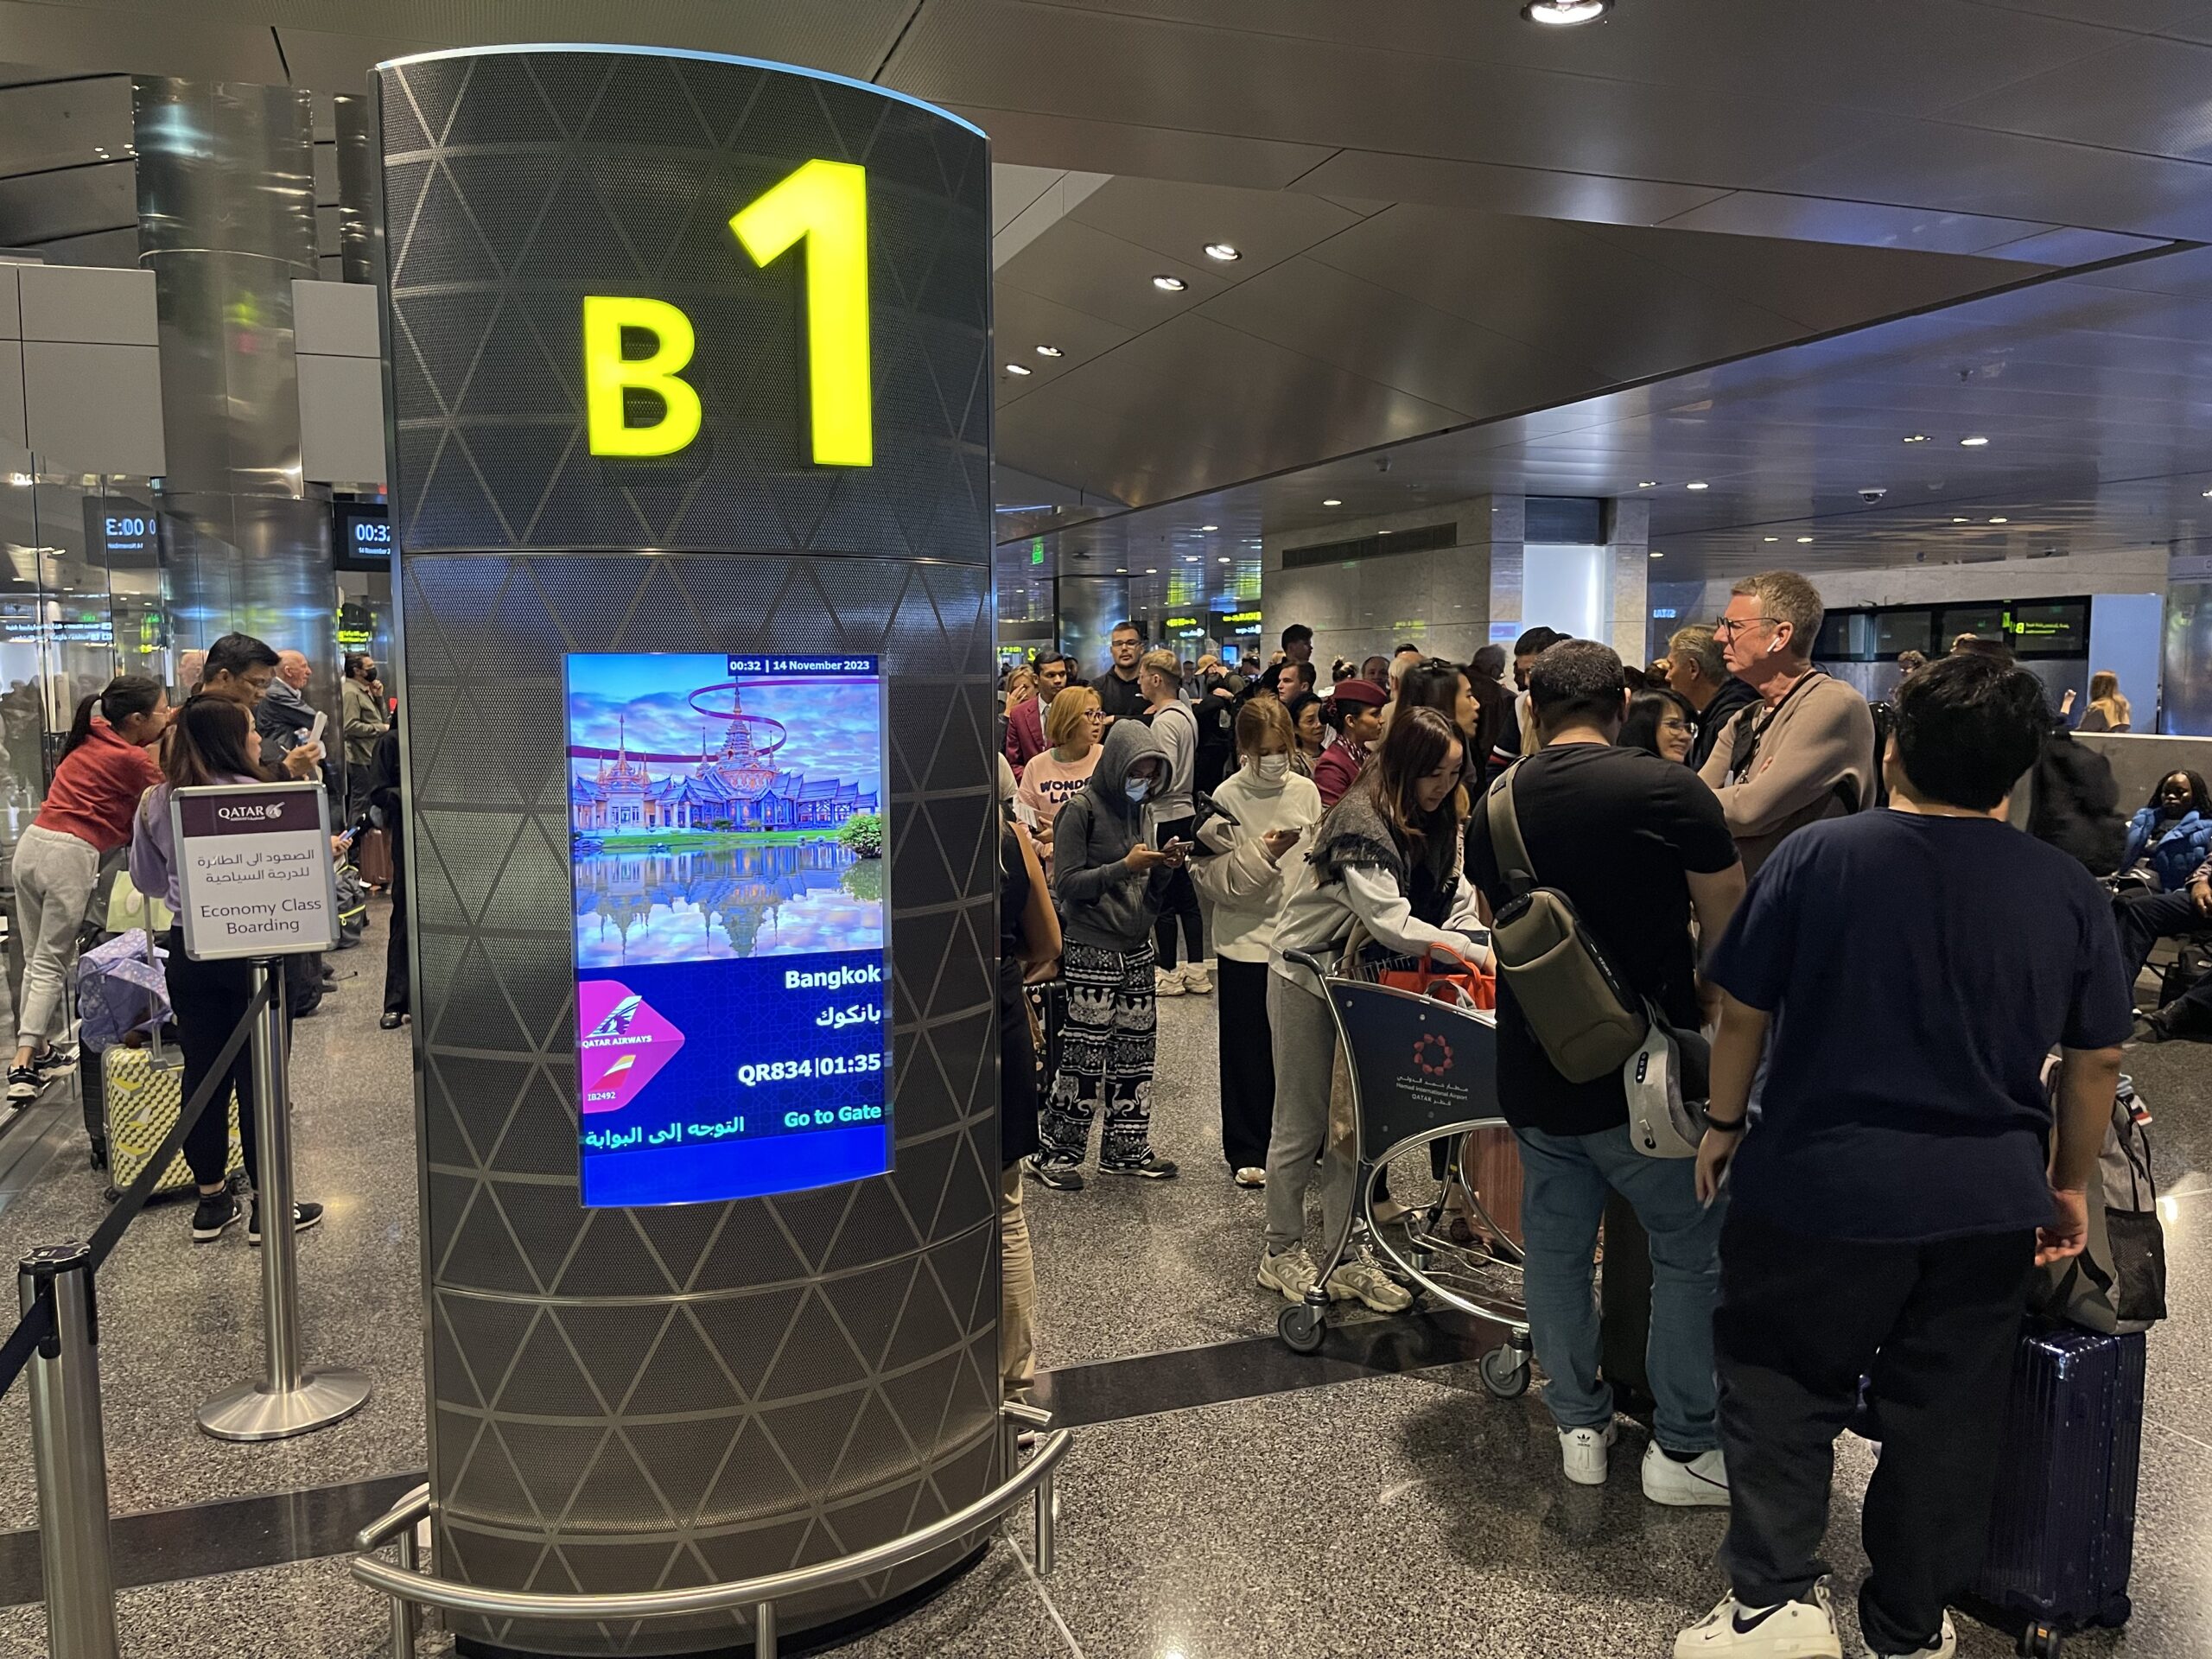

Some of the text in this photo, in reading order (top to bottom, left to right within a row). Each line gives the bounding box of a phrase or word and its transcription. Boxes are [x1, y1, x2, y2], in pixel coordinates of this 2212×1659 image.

[584, 159, 873, 467] B 1
[730, 661, 761, 671] 00:32
[773, 661, 787, 671] 14
[789, 661, 842, 671] November
[844, 661, 870, 671] 2023
[218, 805, 264, 820] QATAR
[266, 849, 315, 864] الصعود
[206, 867, 309, 885] للدرجة السياحية
[200, 899, 321, 918] Economy Class
[226, 918, 300, 935] Boarding
[785, 964, 881, 989] Bangkok
[816, 1003, 881, 1029] بانكوك
[582, 1035, 652, 1048] QATAR AIRWAYS
[588, 1091, 616, 1102] IB2492
[1411, 1093, 1432, 1102] QATAR
[1415, 1086, 1449, 1096] International
[1449, 1091, 1468, 1101] Airport
[785, 1104, 881, 1127] Go to Gate
[585, 1116, 745, 1149] التوجه إلى البوابة
